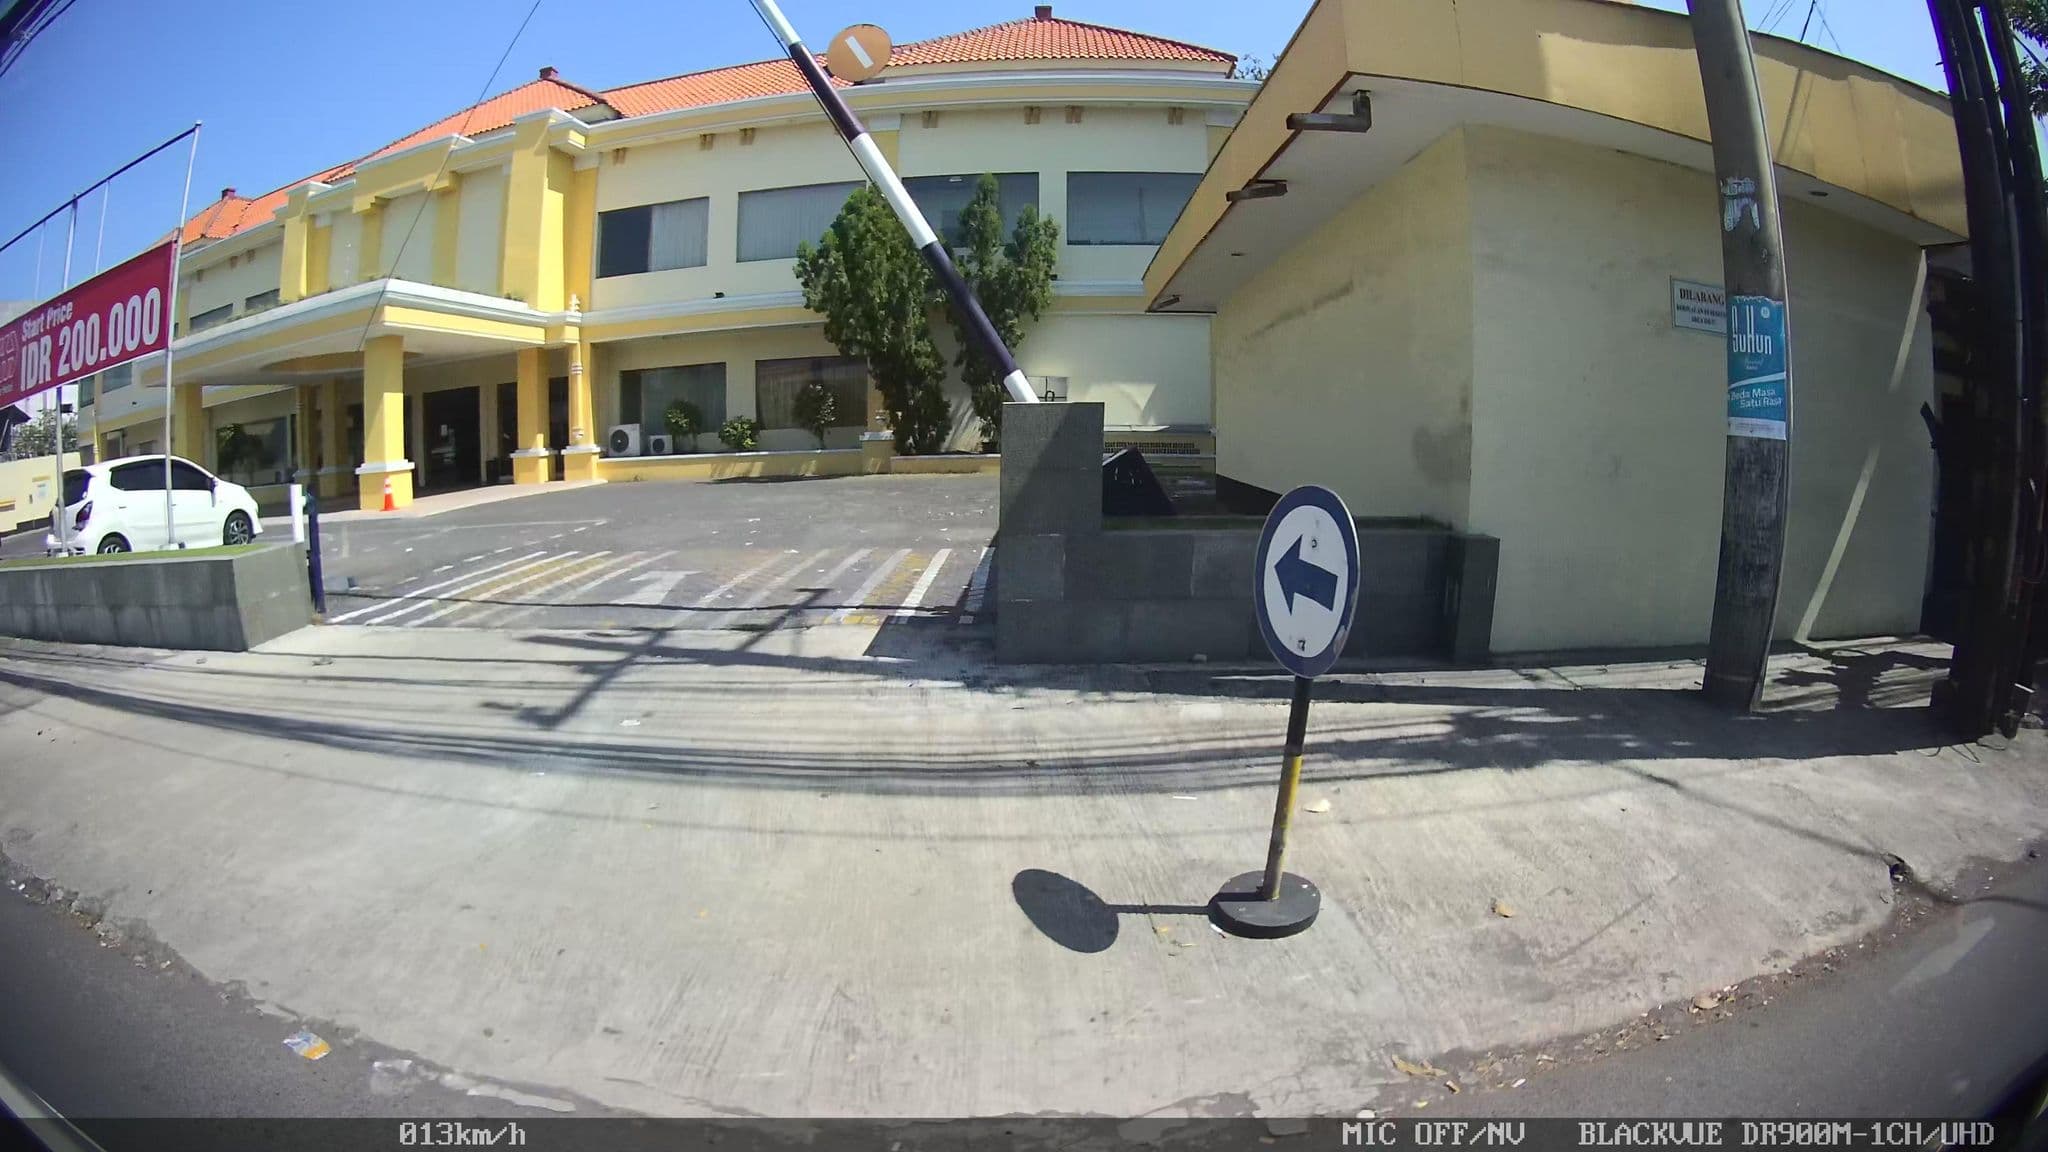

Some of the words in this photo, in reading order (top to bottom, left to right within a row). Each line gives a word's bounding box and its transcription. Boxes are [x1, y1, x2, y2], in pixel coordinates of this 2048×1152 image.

[20, 334, 53, 392] IDR
[57, 286, 162, 377] 200.000
[22, 312, 44, 342] Start
[46, 301, 74, 330] Price
